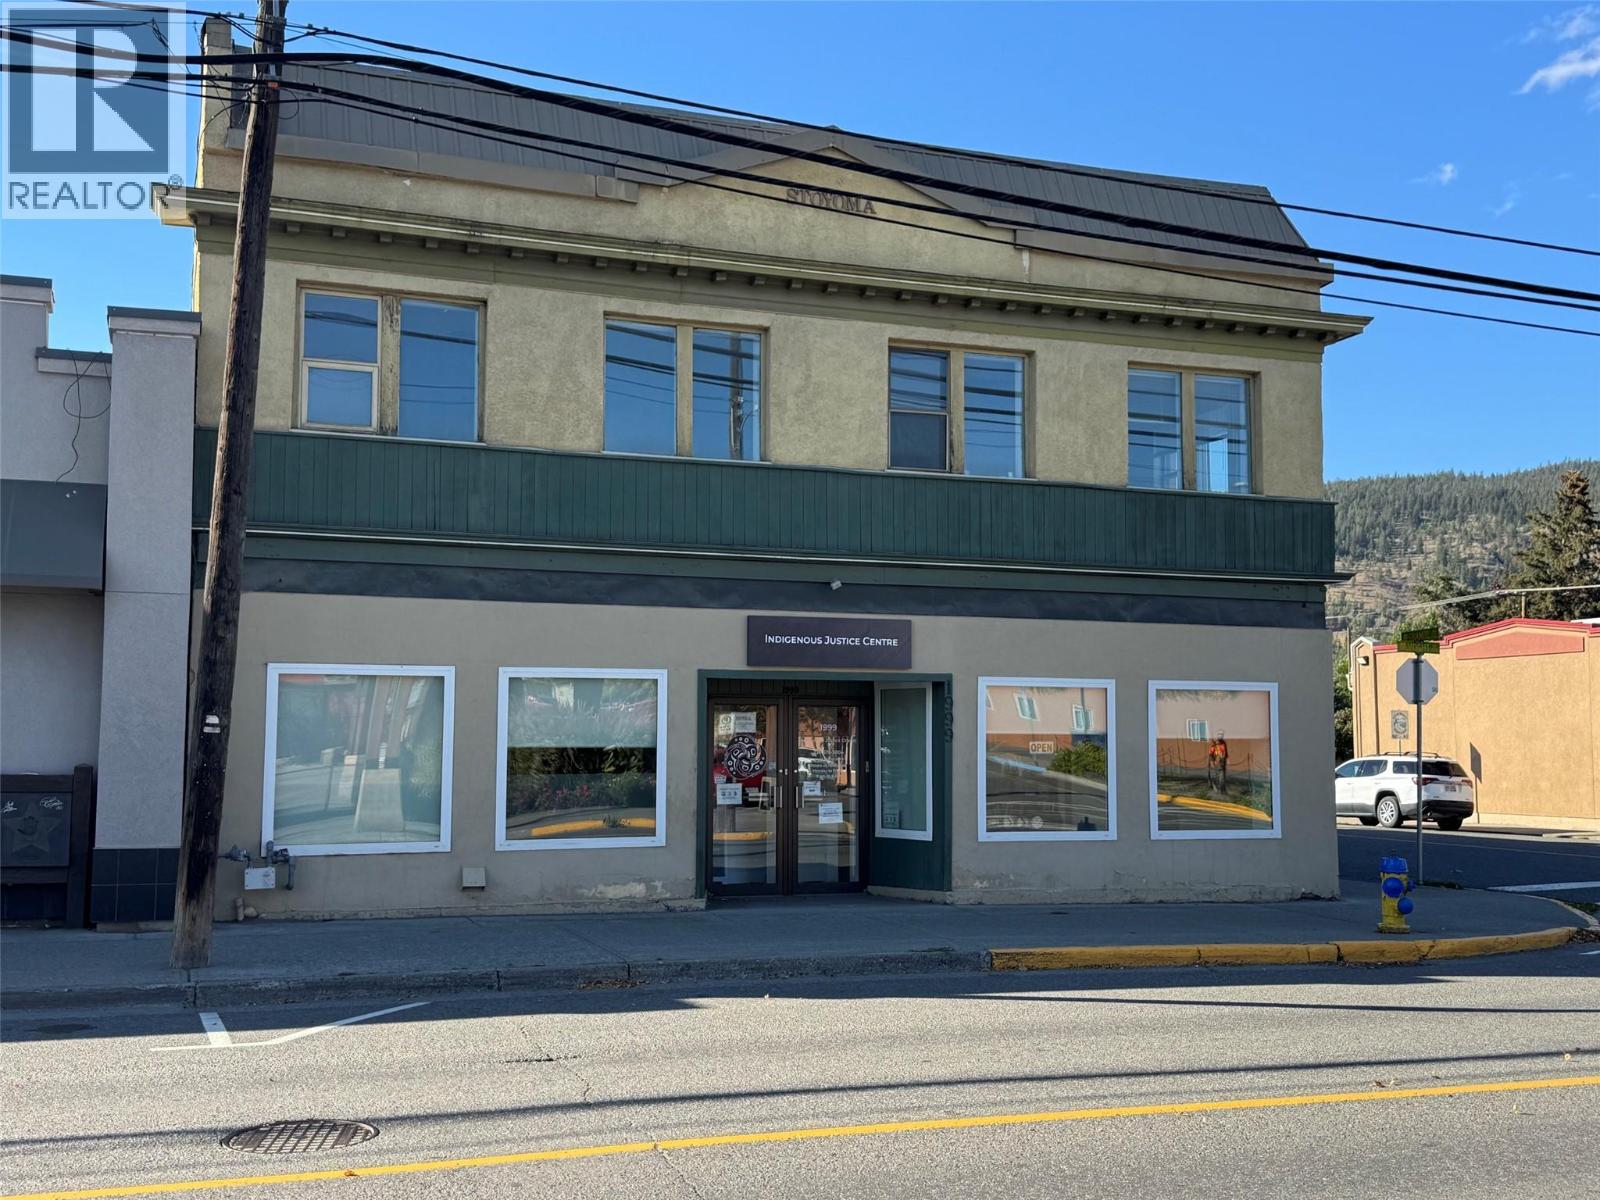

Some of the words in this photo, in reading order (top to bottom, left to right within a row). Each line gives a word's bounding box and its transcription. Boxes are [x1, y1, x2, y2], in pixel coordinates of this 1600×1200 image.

[765, 634, 823, 645] INDIGENOUS
[824, 636, 861, 646] JUSTICE
[862, 636, 899, 647] CENTRE
[820, 723, 838, 732] 1999
[1031, 743, 1053, 752] OPEN
